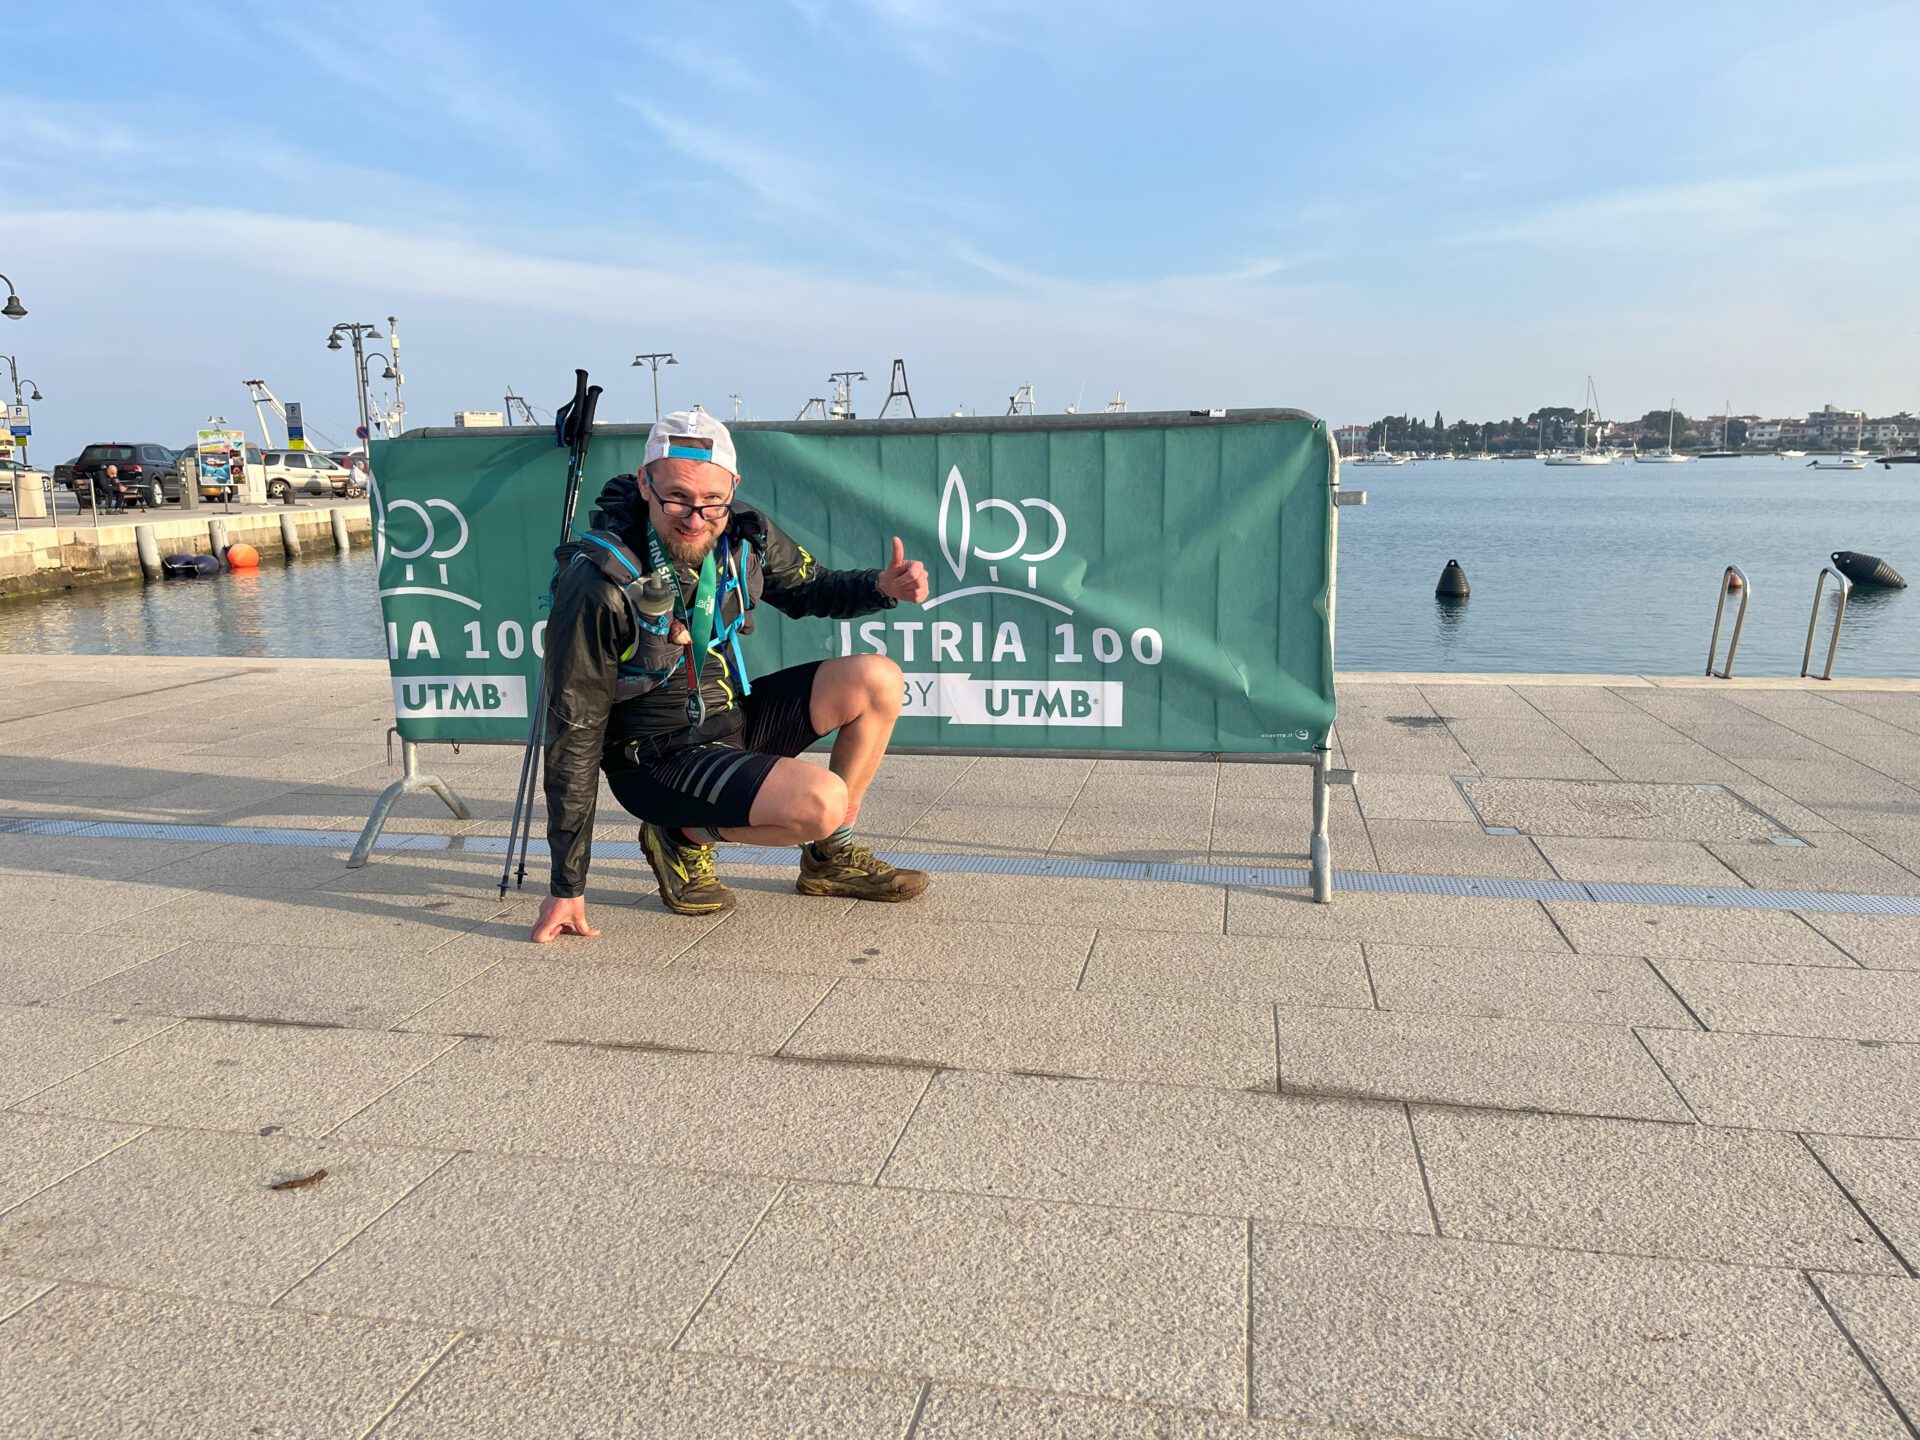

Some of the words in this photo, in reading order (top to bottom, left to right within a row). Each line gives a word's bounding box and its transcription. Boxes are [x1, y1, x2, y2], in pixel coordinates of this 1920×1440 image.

[648, 540, 680, 598] FINISHER
[840, 621, 1026, 662] ISTRIA
[1055, 623, 1163, 665] 100
